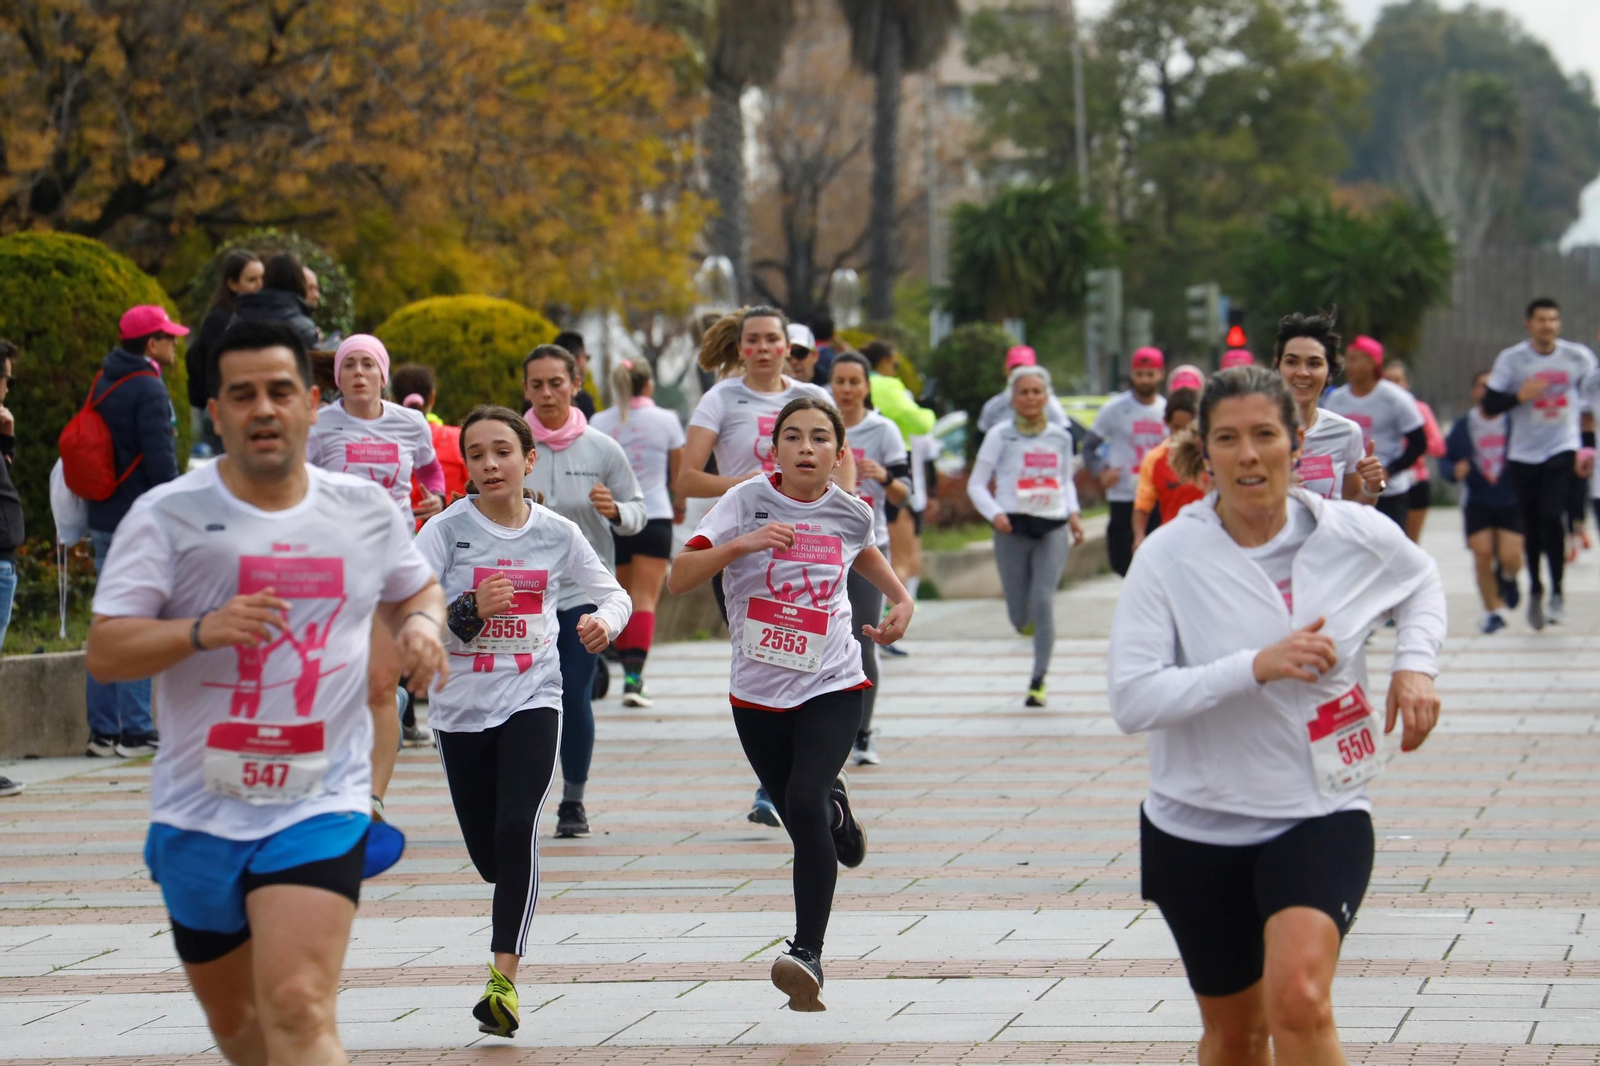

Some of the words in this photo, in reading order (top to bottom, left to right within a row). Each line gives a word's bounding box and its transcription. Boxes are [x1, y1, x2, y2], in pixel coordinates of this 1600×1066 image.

[791, 551, 816, 559] CADENA
[801, 544, 836, 554] RUNNING
[512, 580, 540, 588] NNING
[480, 619, 527, 639] 2559
[760, 628, 808, 656] 2553
[1337, 728, 1375, 766] 550
[242, 762, 290, 788] 547
